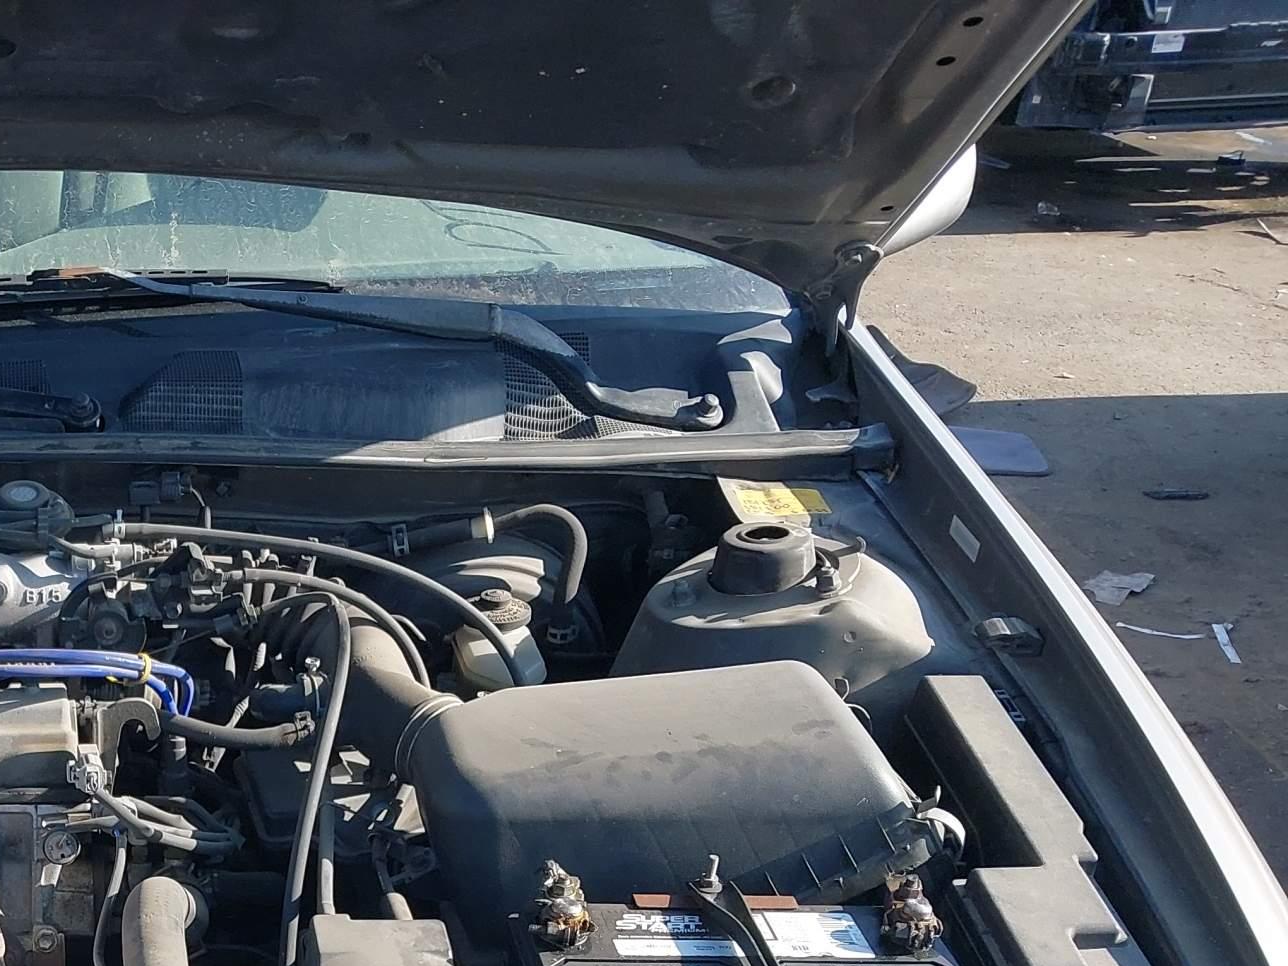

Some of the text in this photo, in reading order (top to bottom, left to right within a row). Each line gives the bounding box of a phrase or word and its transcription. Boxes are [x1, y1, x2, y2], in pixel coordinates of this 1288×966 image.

[22, 588, 62, 605] B15
[622, 913, 701, 923] SUPER
[615, 919, 703, 931] START
